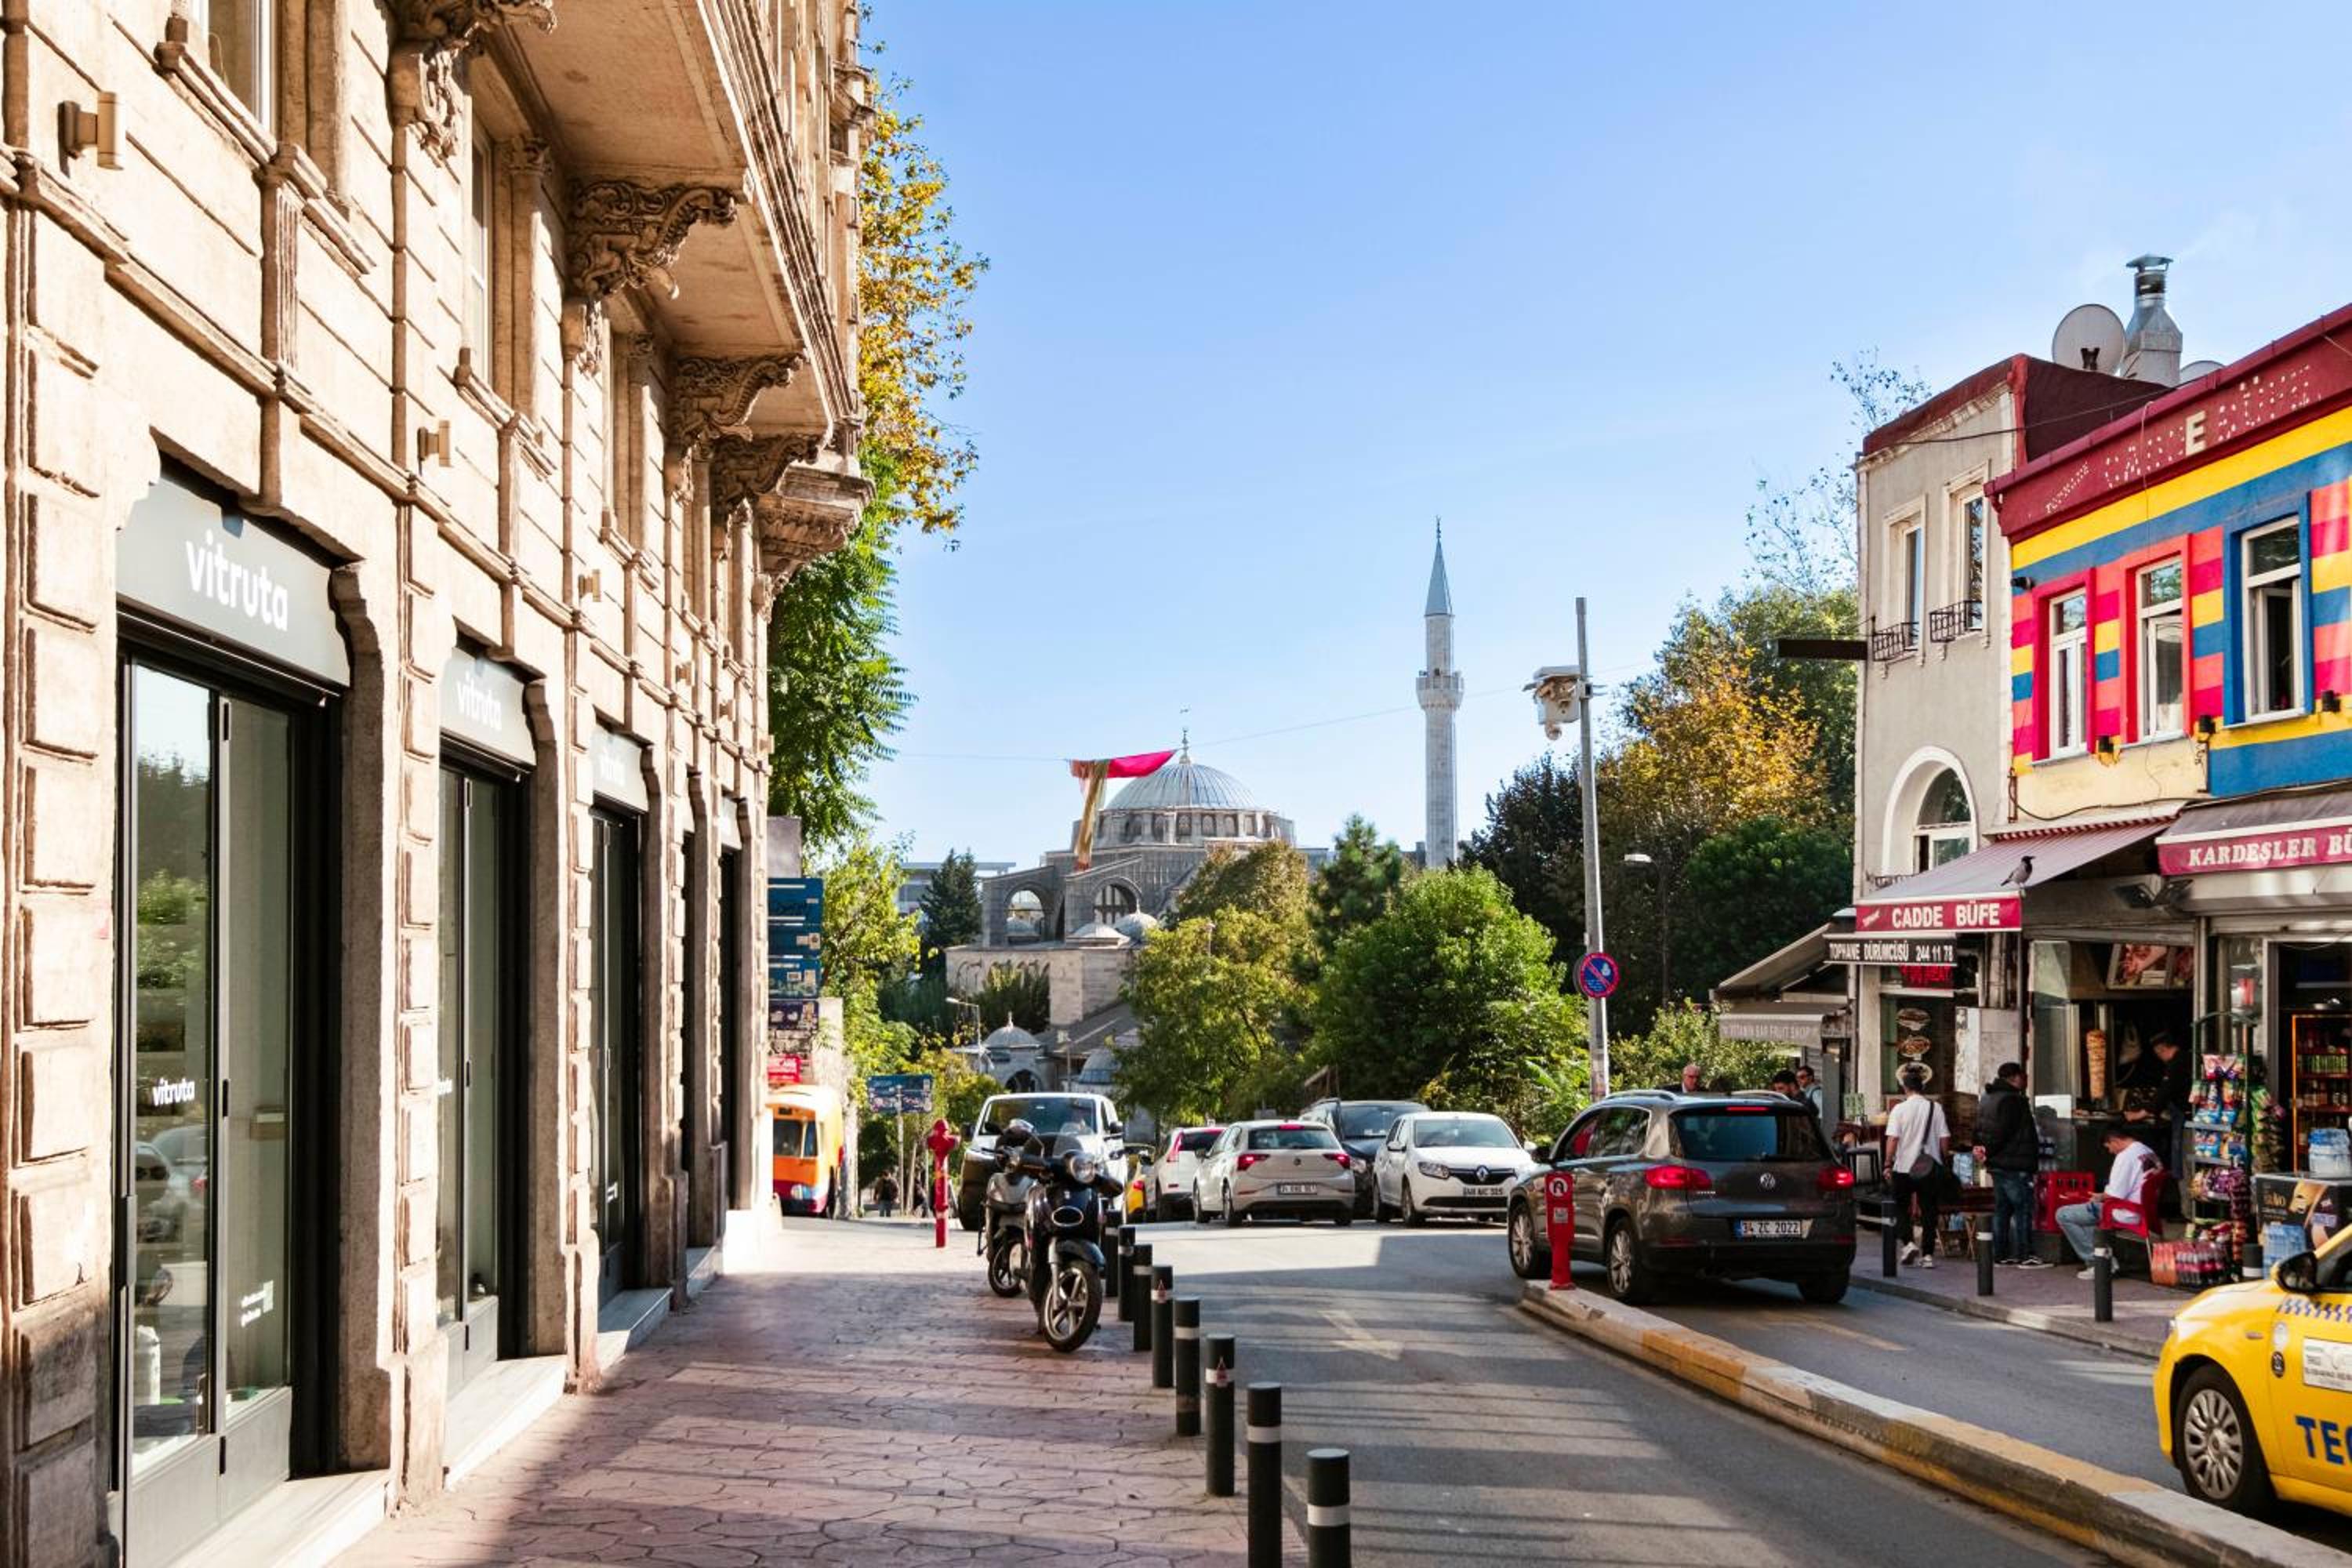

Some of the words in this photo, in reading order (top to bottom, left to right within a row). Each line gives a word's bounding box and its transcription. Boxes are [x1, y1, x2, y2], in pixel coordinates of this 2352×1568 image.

[186, 528, 288, 632] vitruta
[456, 670, 502, 731] vitruta
[1892, 906, 1944, 929] CADDE
[1955, 900, 2000, 927] BÜFE
[1829, 943, 1860, 960] TOPHANE
[1915, 945, 1930, 961] 244
[1932, 945, 1941, 961] 11
[152, 1076, 195, 1106] vitruta
[1743, 1222, 1754, 1233] 34
[1774, 1222, 1798, 1233] 2022
